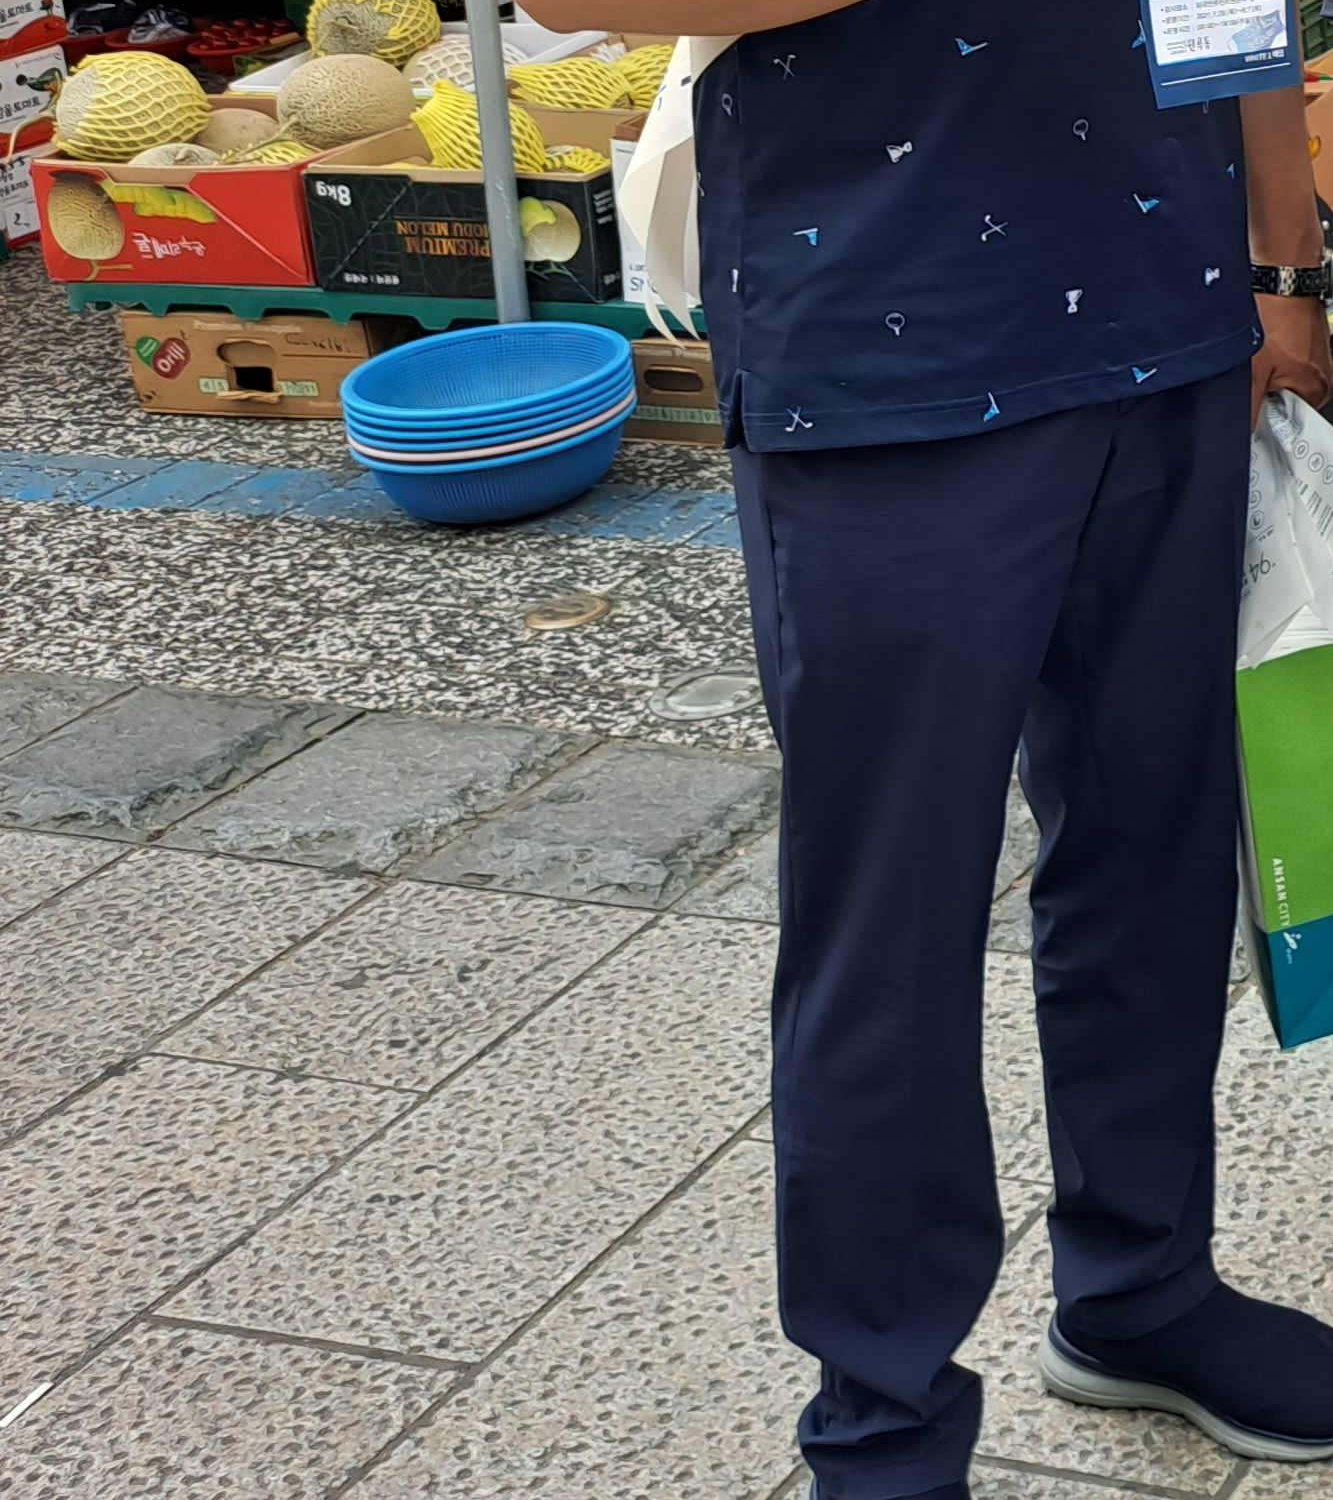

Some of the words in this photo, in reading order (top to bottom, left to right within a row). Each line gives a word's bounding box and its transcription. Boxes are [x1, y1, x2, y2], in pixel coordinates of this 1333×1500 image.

[316, 180, 351, 206] 8kg
[396, 220, 448, 236] MELON
[405, 237, 491, 258] PREMIUM
[1272, 858, 1288, 901] ANSAN
[1278, 902, 1291, 927] CITY
